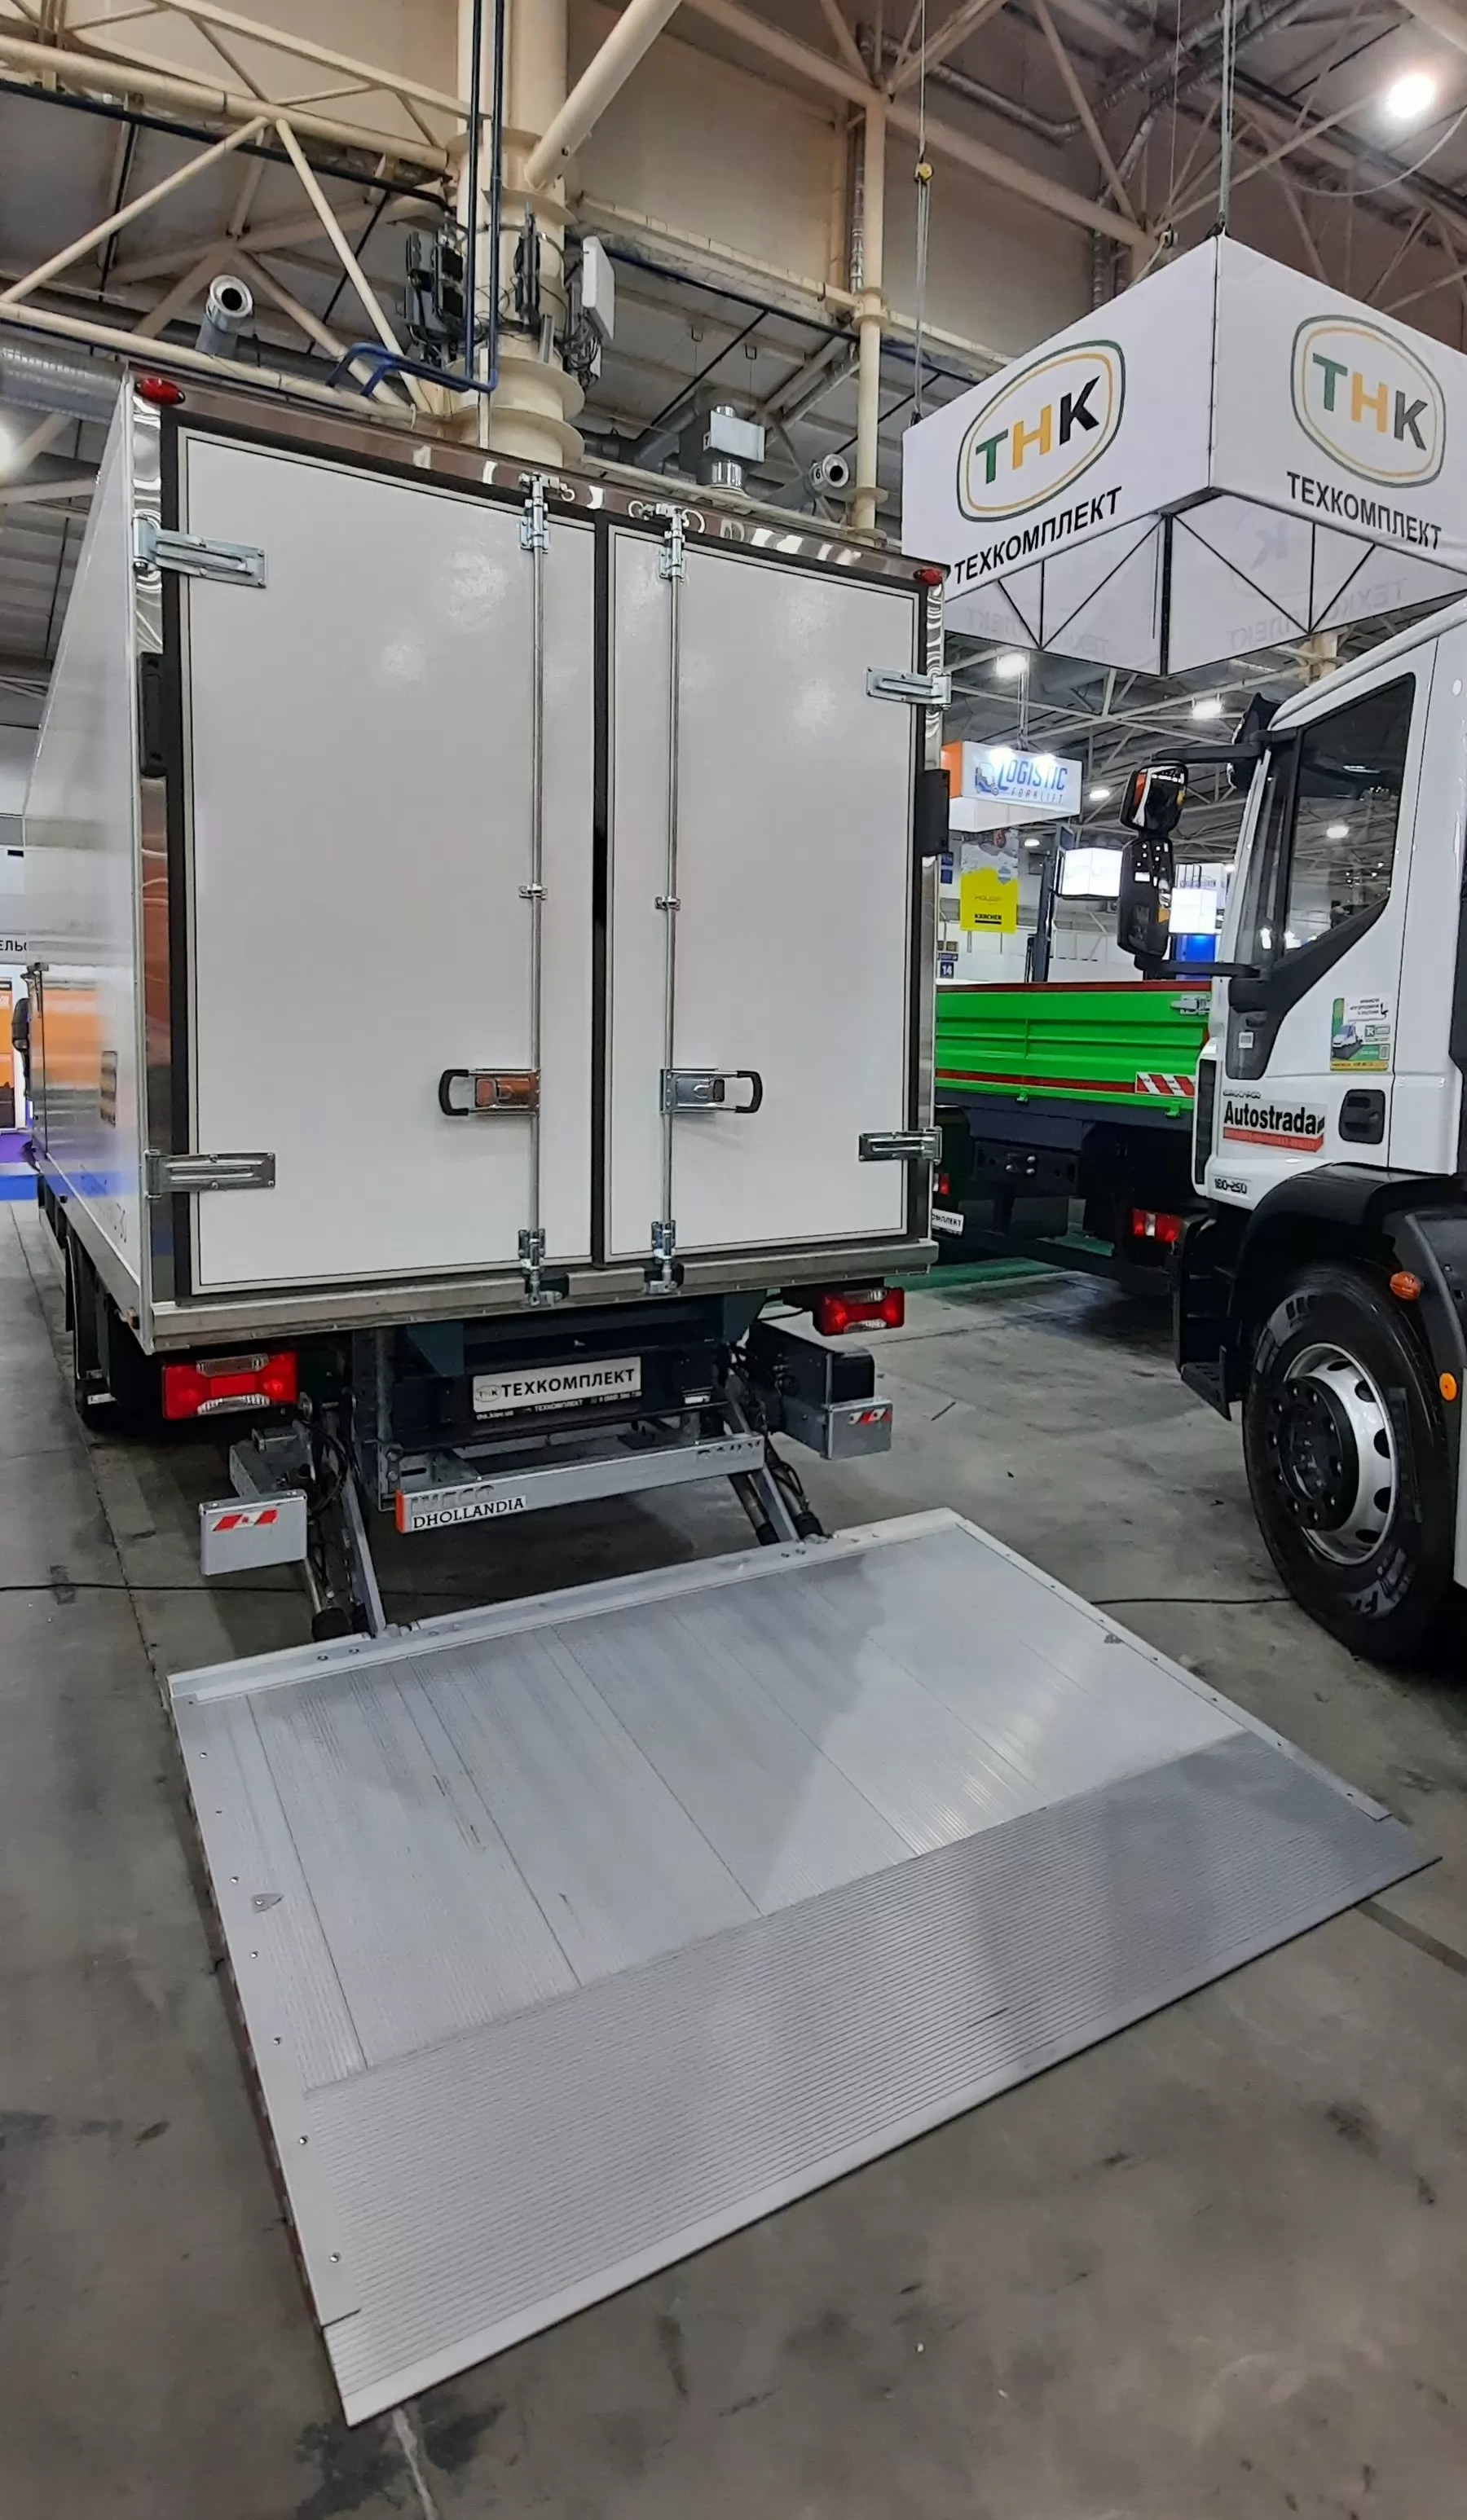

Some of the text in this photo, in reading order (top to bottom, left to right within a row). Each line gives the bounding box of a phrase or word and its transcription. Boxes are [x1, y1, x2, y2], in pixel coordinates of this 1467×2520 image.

[1311, 353, 1429, 451] ТНК
[976, 376, 1100, 485] ТНК
[1287, 471, 1442, 550] ТЕХКОМПЛЕКТ
[954, 486, 1122, 585] ТЕХКОМПЛЕКТ
[998, 759, 1068, 790] LOGISTIC
[1011, 787, 1063, 803] FORKLIFT
[941, 965, 952, 976] 14
[1224, 1101, 1316, 1135] Autostrada
[501, 1369, 635, 1398] ТЕХКОМПЛЕКТ
[413, 1497, 524, 1528] DHOLLANDIA
